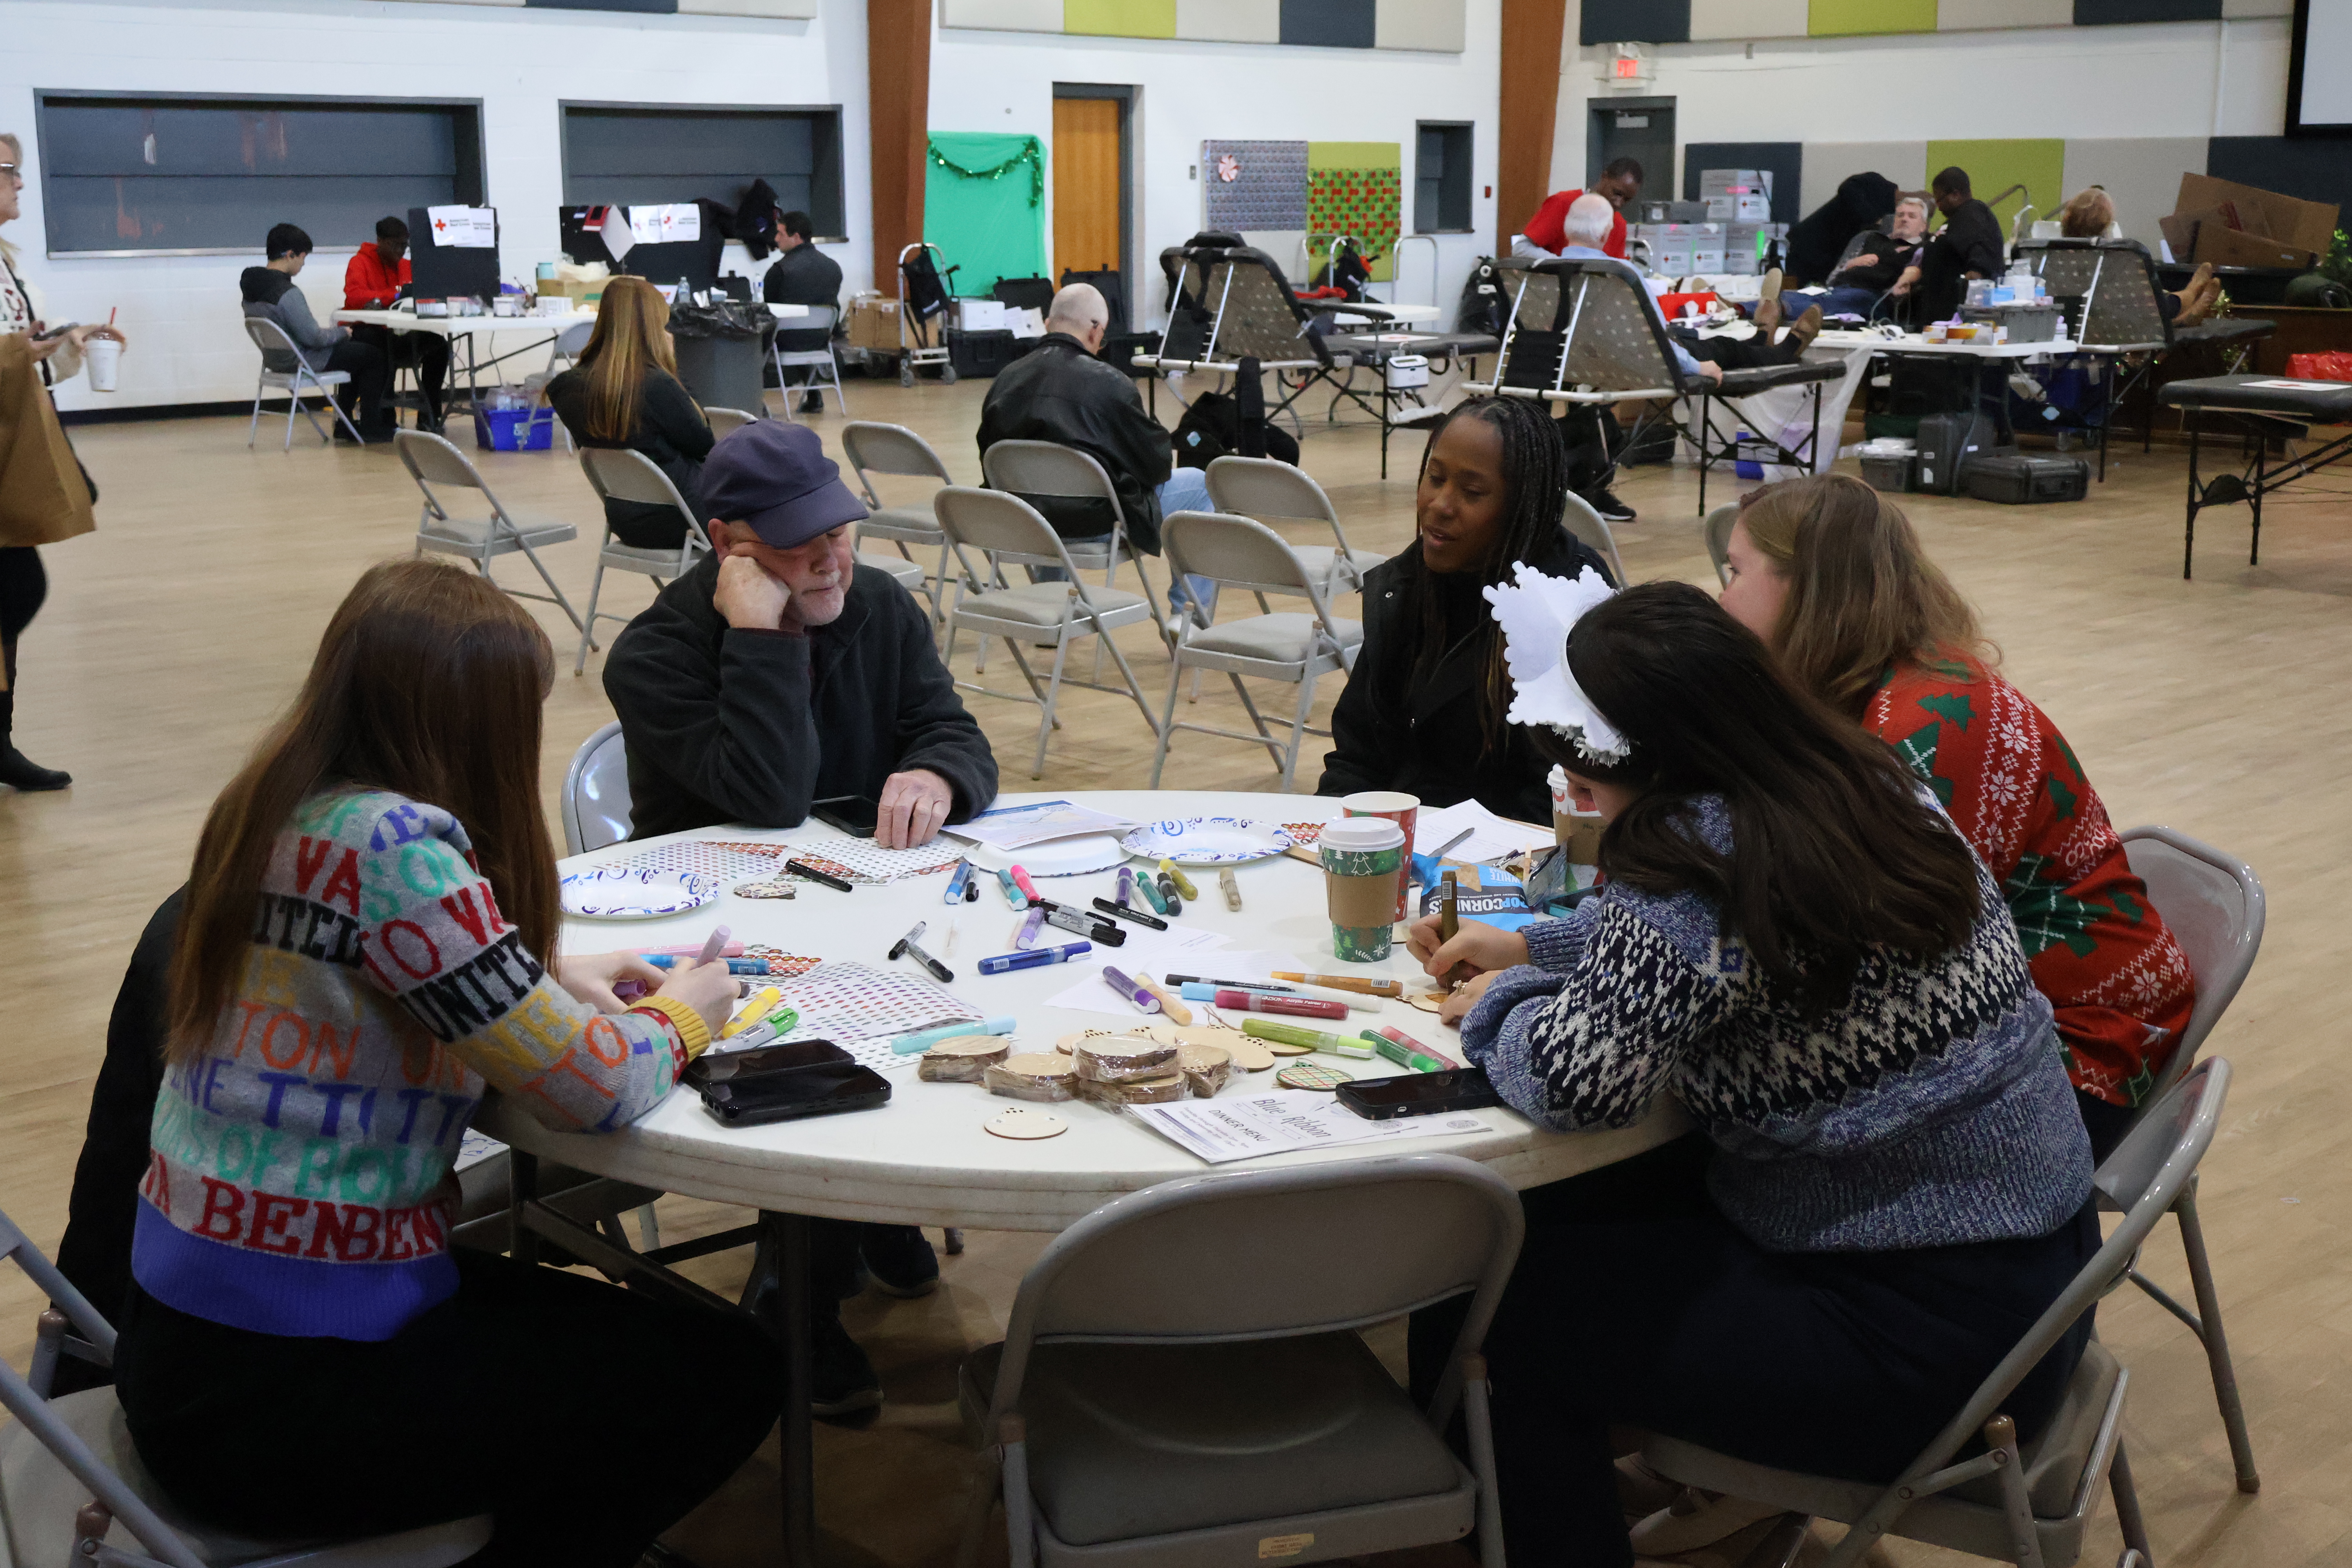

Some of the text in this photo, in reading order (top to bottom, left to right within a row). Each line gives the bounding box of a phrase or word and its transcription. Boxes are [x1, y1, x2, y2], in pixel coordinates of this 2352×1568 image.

[1208, 1110, 1244, 1128] DINNER
[1238, 1128, 1270, 1142] MENU
[1252, 1099, 1287, 1114] Blue
[1280, 1116, 1332, 1138] Ribbon
